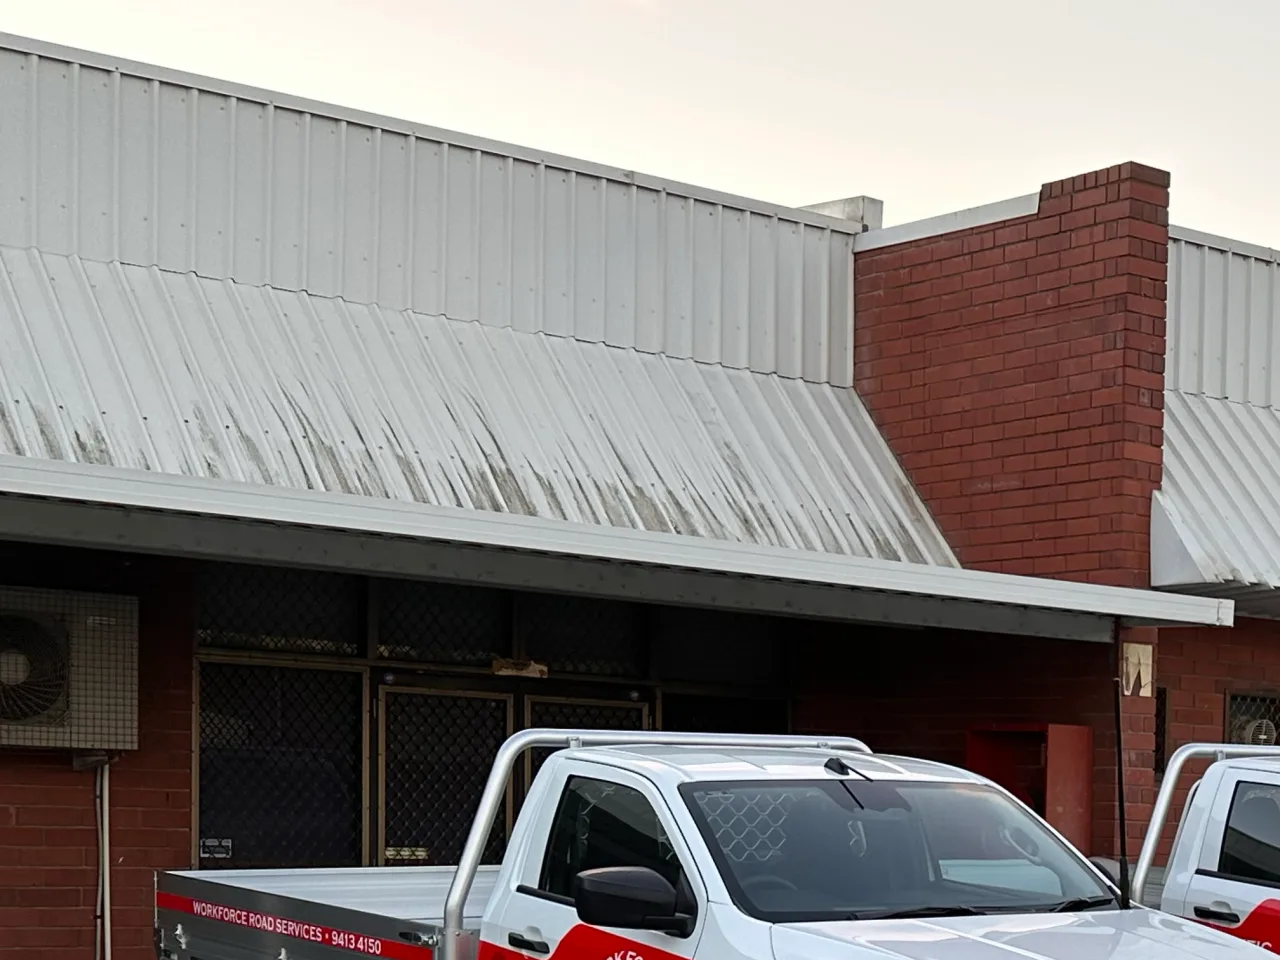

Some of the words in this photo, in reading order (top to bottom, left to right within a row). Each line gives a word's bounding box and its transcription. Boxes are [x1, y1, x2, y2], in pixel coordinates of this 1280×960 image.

[193, 900, 248, 926] WORKFORCE
[249, 913, 275, 931] ROAD
[275, 919, 322, 942] SERVICES
[331, 931, 356, 949] 9413
[357, 936, 382, 955] 4150
